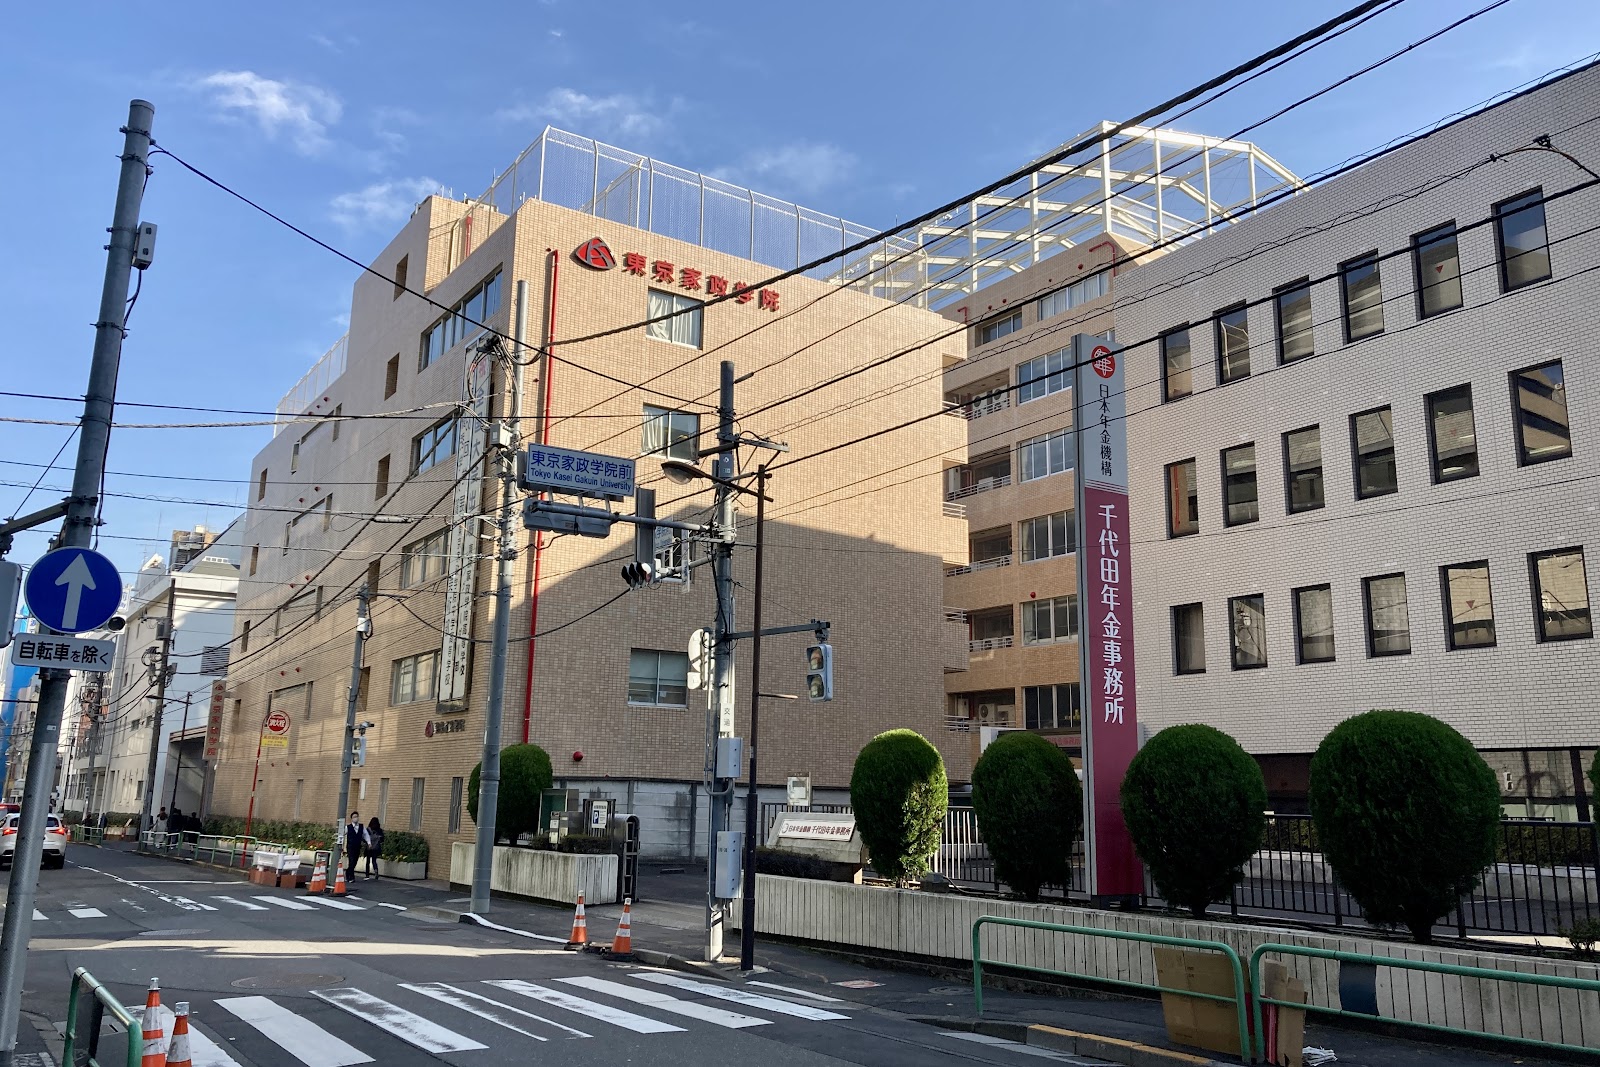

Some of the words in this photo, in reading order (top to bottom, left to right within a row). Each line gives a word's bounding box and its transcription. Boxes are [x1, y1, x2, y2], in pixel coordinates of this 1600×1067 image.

[623, 252, 780, 312] 東京家政学院
[1098, 383, 1113, 477] 日本年金機構
[530, 450, 632, 480] 東京家政学院前
[530, 467, 552, 480] Tokyo
[553, 471, 573, 482] Kasei
[574, 474, 598, 486] Gakuin
[600, 477, 632, 492] University
[1098, 503, 1125, 725] 千代田年金事務所
[19, 640, 109, 665] 自転車を除く
